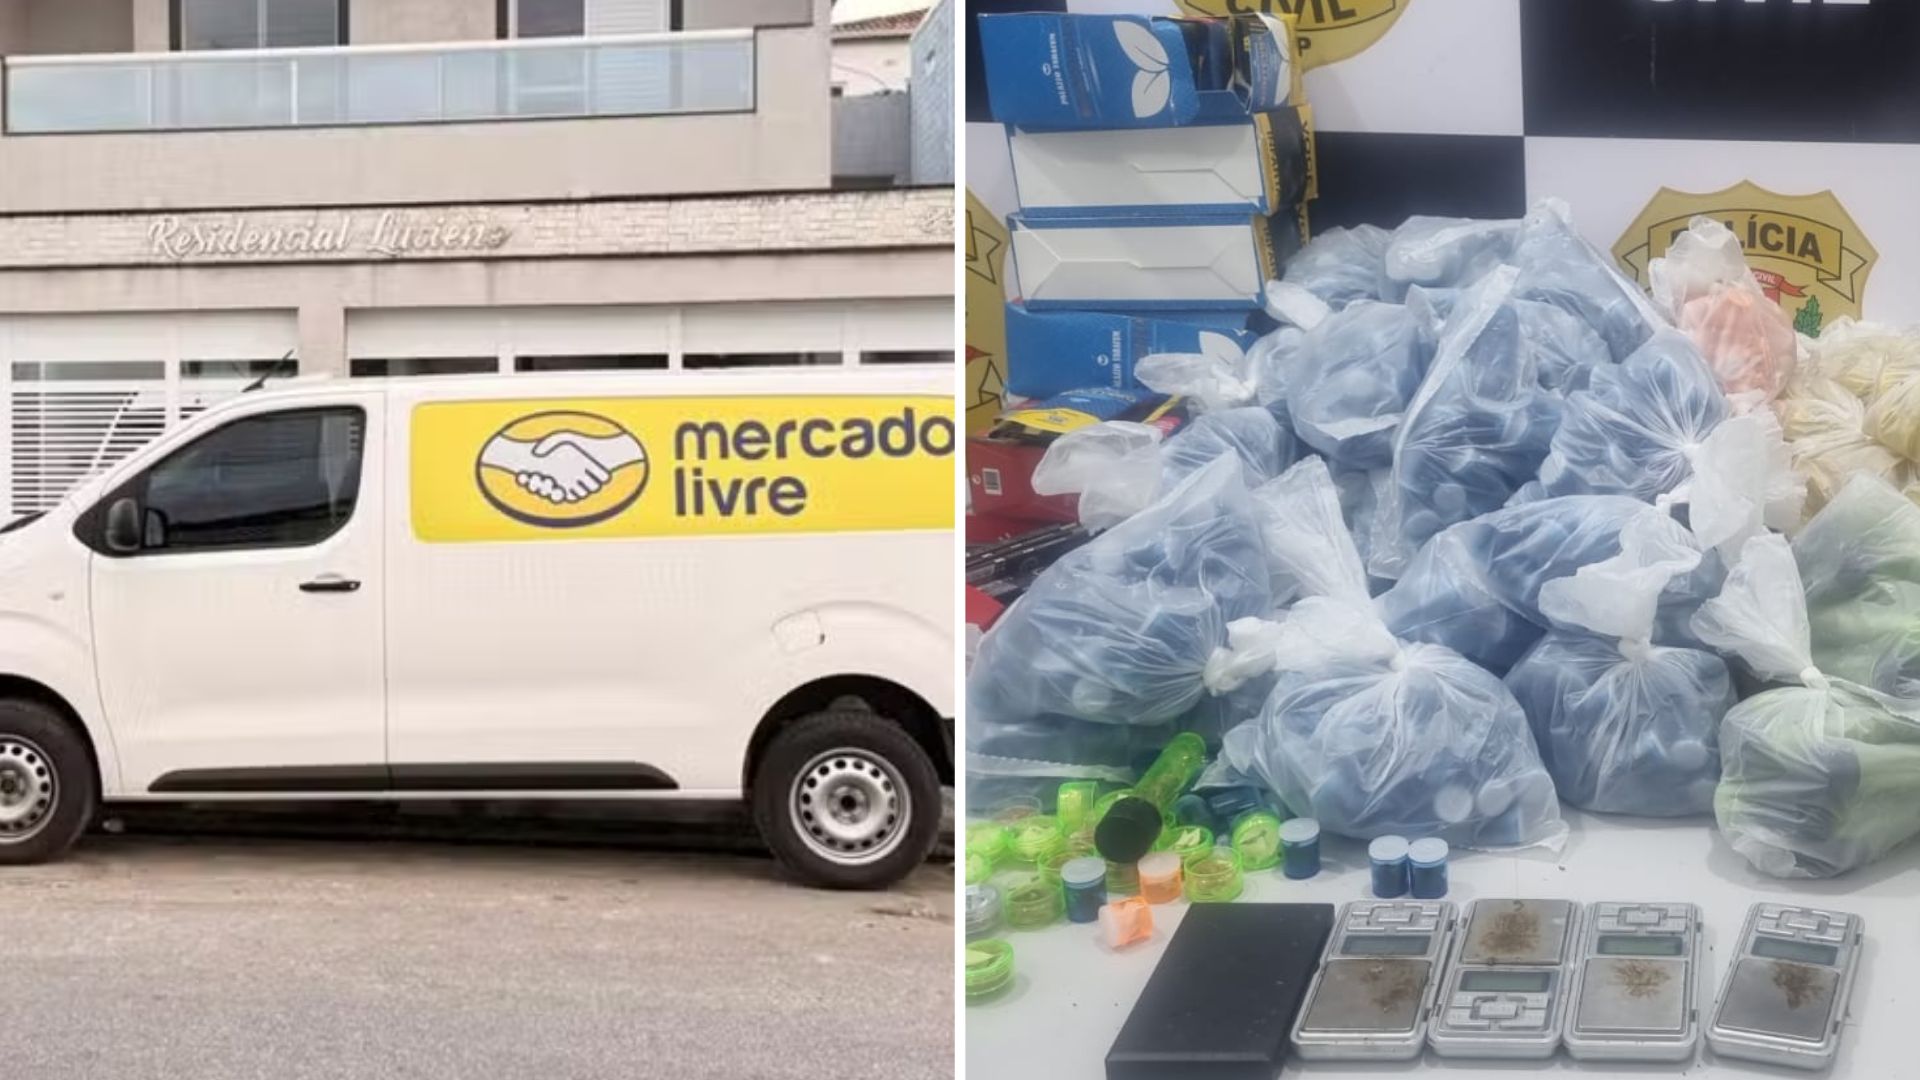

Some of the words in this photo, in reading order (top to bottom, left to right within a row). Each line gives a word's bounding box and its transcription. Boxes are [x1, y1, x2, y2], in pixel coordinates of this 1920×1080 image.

[148, 215, 351, 260] Residencial
[675, 406, 955, 460] mercado
[675, 467, 807, 517] livre
